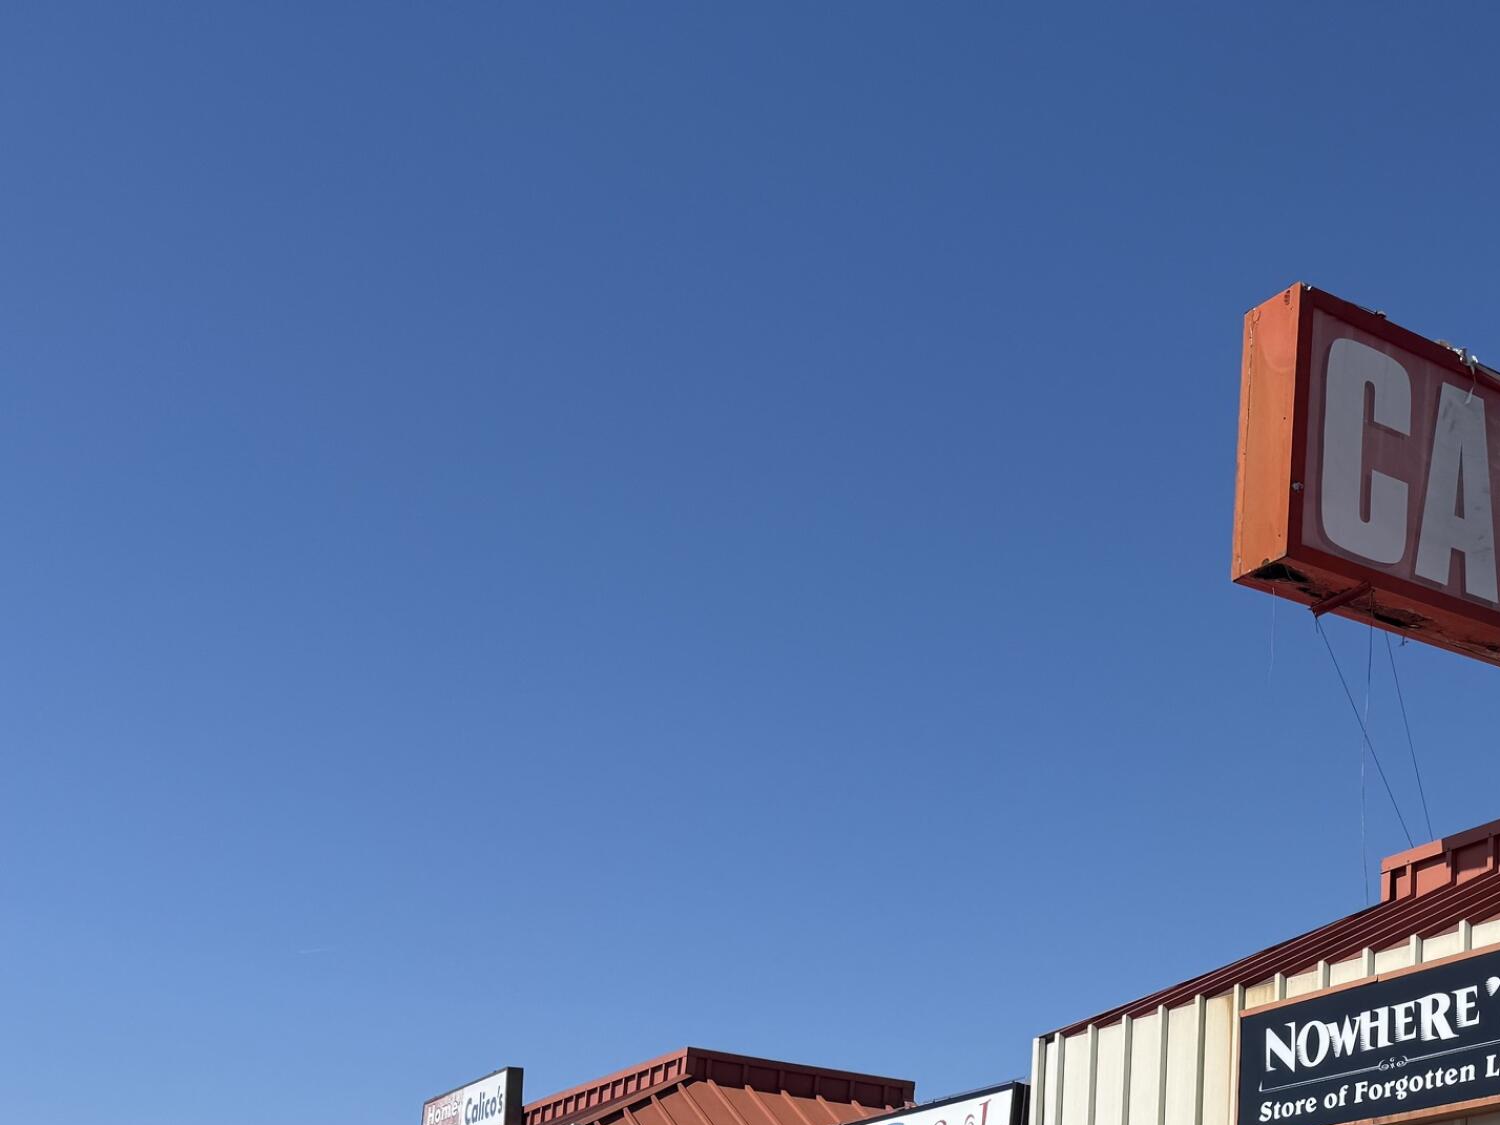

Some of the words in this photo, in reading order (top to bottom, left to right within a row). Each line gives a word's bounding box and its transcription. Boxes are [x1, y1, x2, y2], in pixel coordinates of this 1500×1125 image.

[426, 1099, 458, 1125] Home
[464, 1086, 503, 1125] Calico's
[1259, 1096, 1317, 1122] Store
[1324, 1085, 1348, 1109] of
[1354, 1063, 1476, 1100] Forgotten
